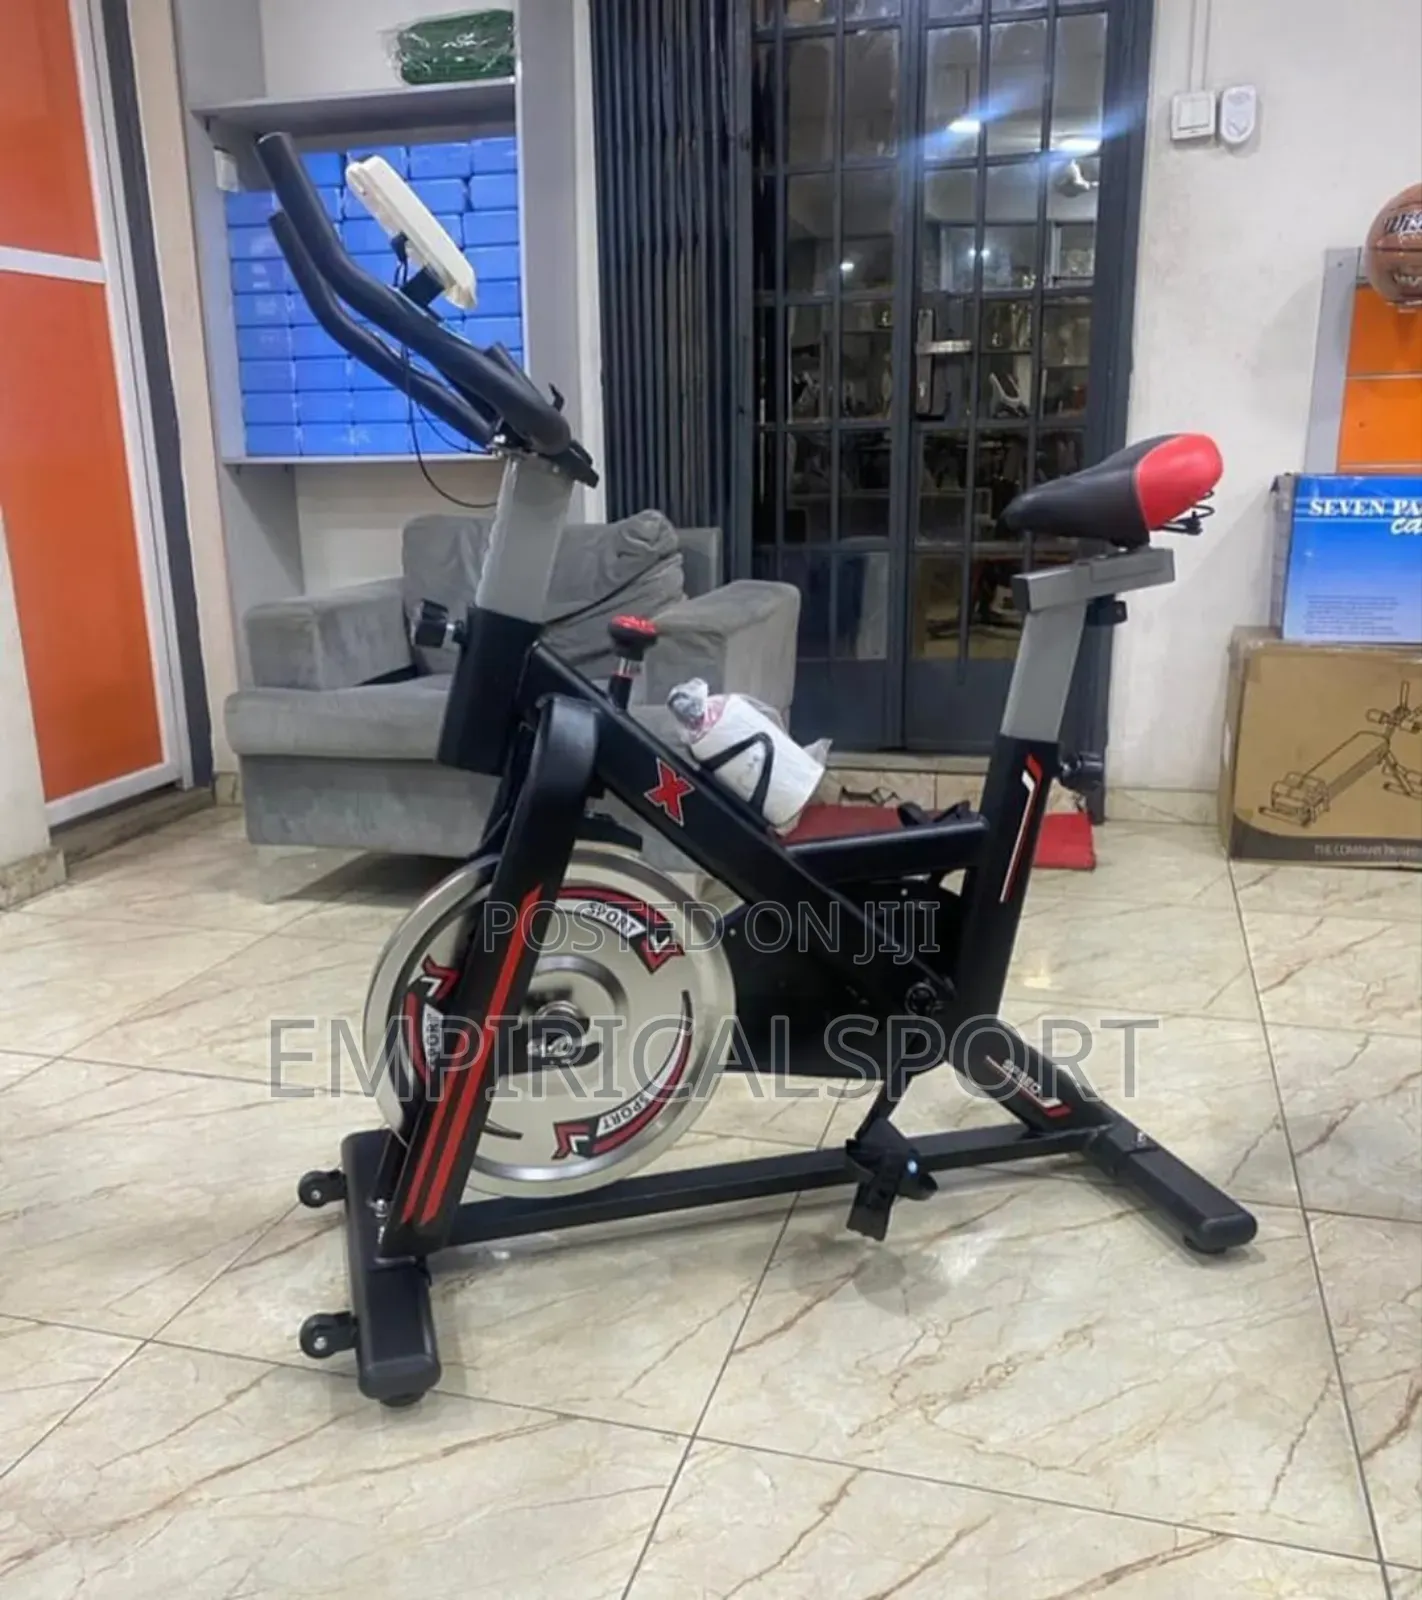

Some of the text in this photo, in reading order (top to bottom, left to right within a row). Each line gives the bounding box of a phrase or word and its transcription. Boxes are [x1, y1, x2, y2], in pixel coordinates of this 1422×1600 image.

[1309, 498, 1385, 516] SEVEN
[587, 902, 637, 933] SPORT
[602, 1093, 650, 1130] SPORT
